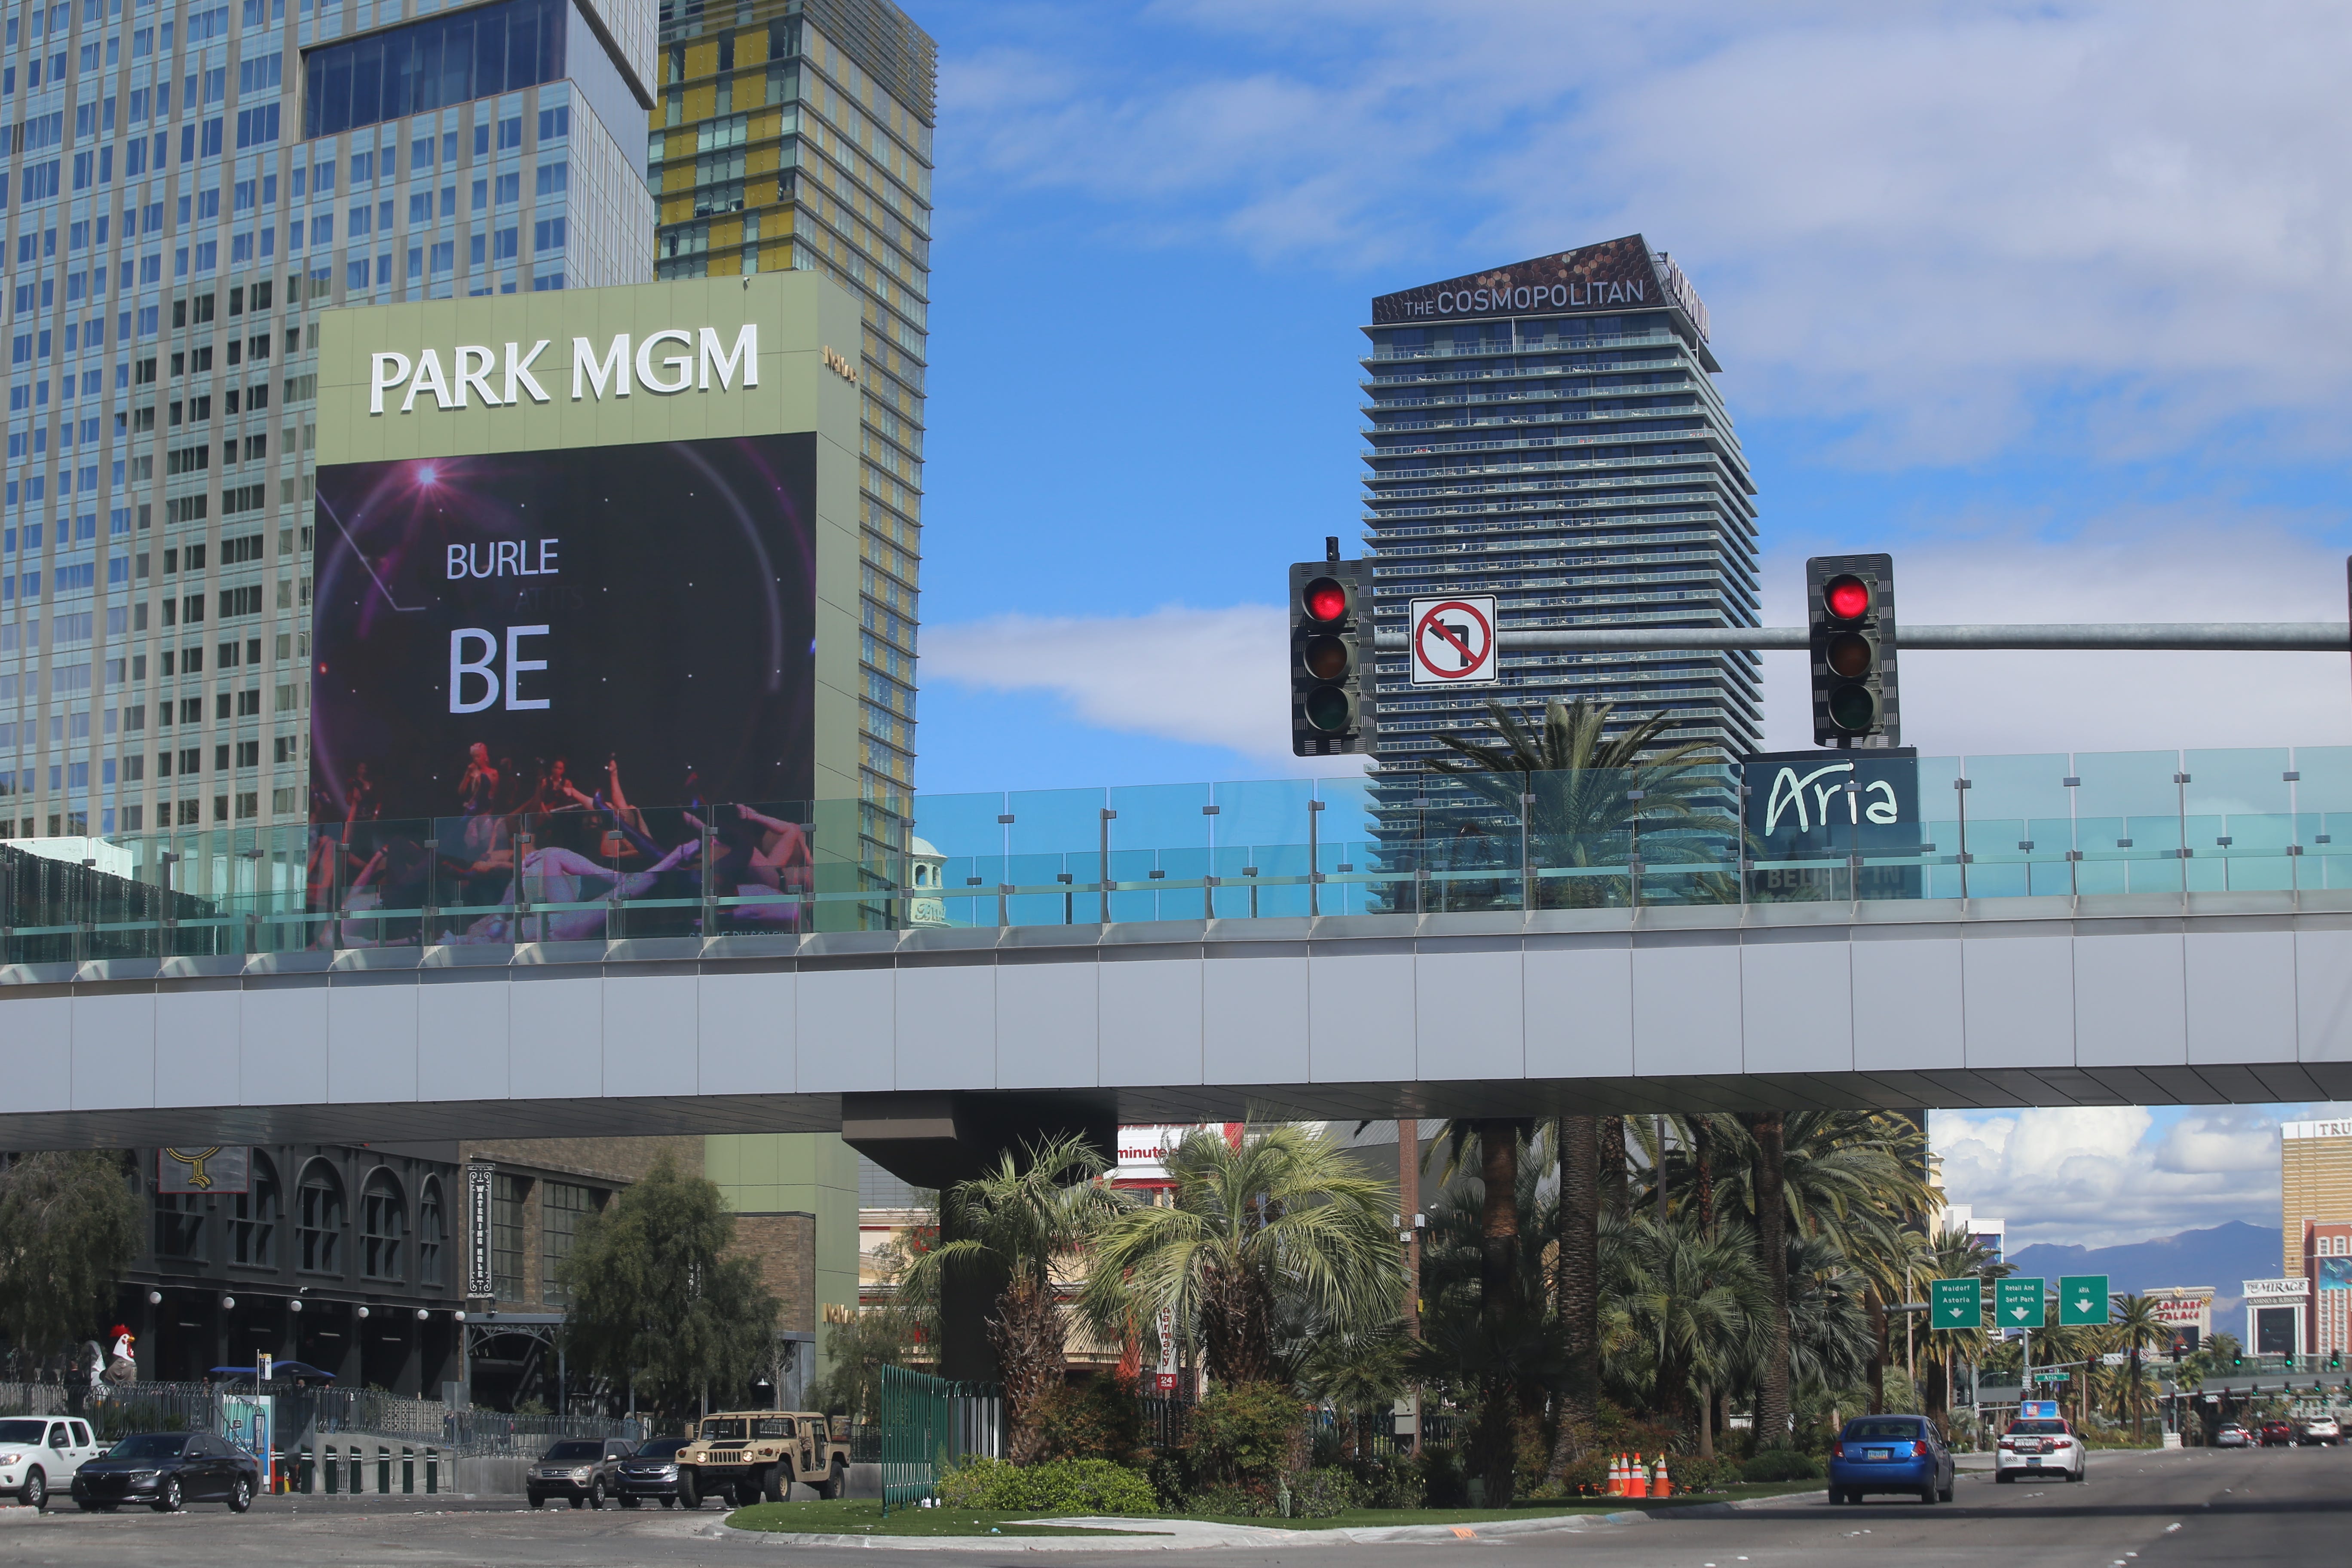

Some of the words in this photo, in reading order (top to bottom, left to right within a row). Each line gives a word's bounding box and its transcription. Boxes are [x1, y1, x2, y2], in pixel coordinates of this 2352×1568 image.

[1404, 301, 1434, 316] THE
[1437, 279, 1644, 314] COSMOPOLITAN
[370, 339, 551, 413] PARK
[571, 324, 759, 400] MGM
[447, 538, 559, 580] BURLE
[449, 624, 550, 714] BE
[1765, 762, 1898, 837] Aria
[2319, 1122, 2352, 1135] TRU
[1117, 1146, 1167, 1158] minute
[476, 1185, 485, 1245] WATERING
[2252, 1281, 2305, 1293] MIRAGE
